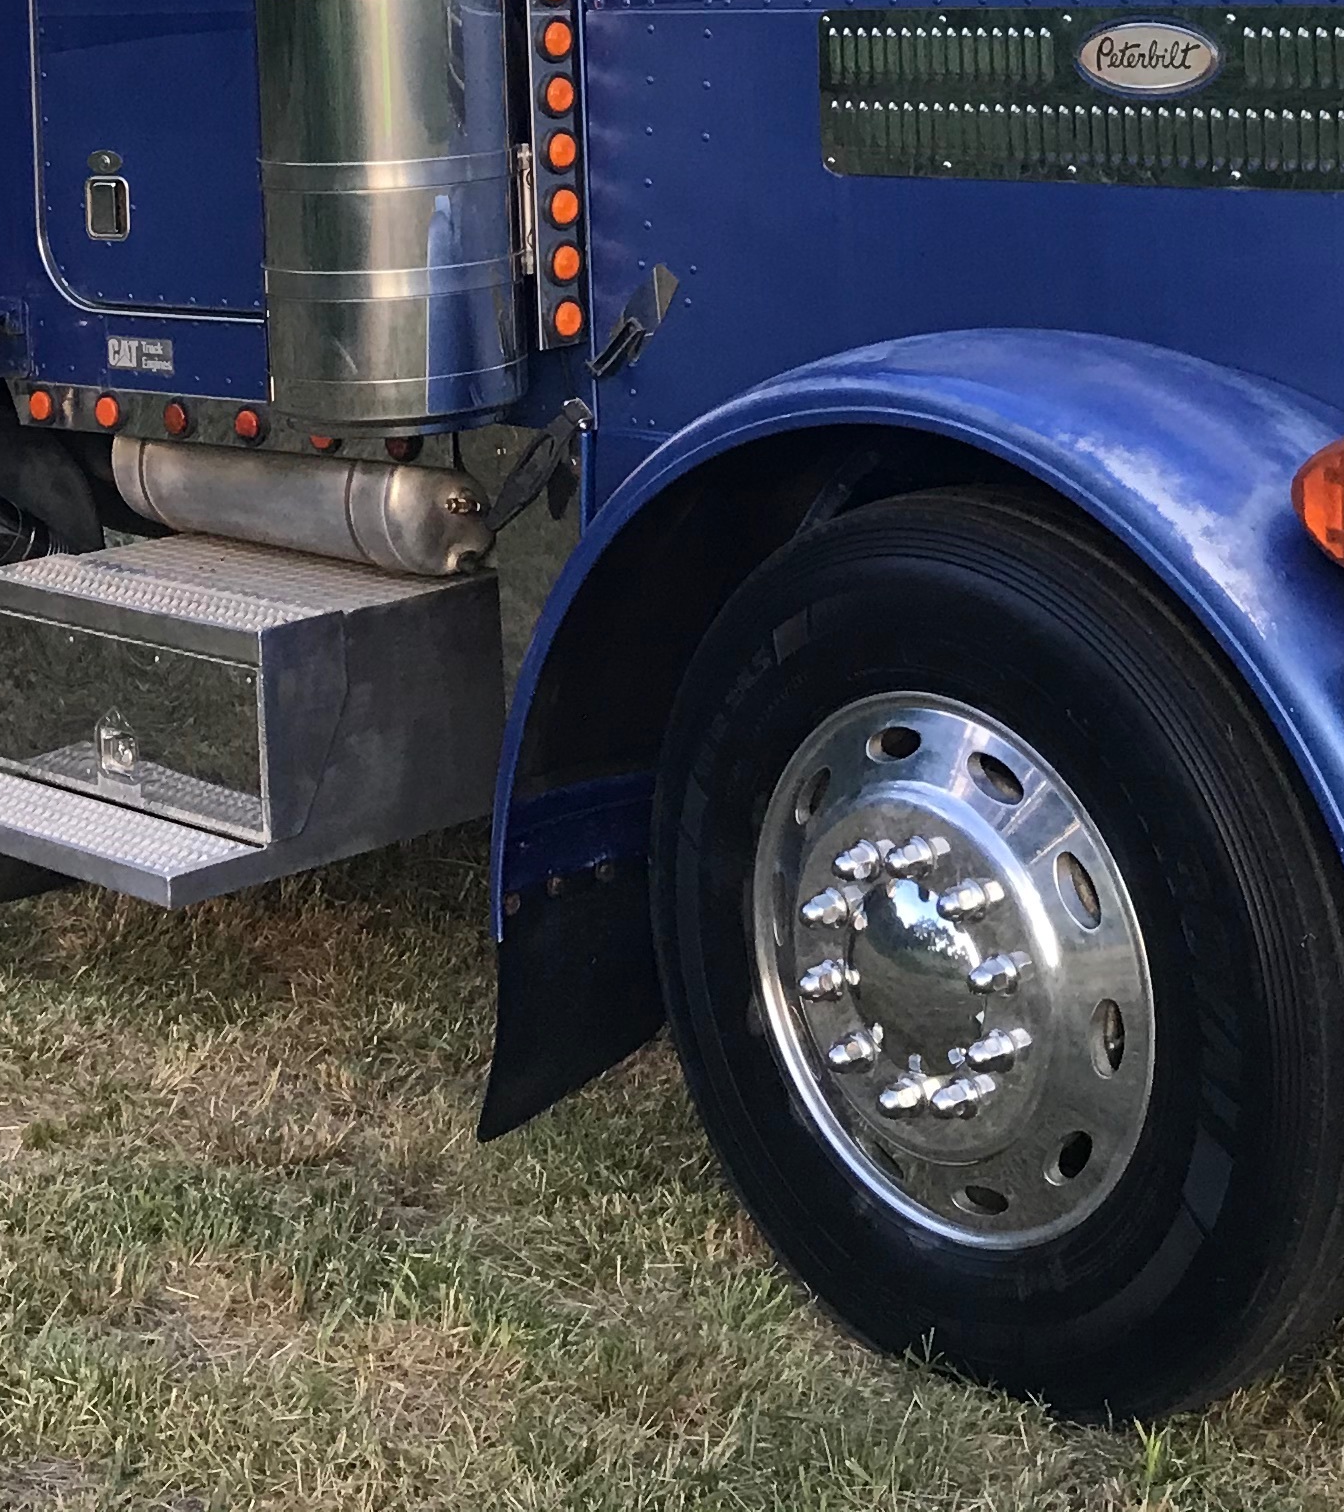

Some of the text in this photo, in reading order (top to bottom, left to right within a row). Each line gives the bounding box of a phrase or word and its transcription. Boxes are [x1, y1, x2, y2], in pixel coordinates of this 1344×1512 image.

[1096, 36, 1202, 72] Peterbilt
[108, 338, 139, 367] CAT
[141, 341, 164, 354] Truck
[142, 356, 173, 372] Engines
